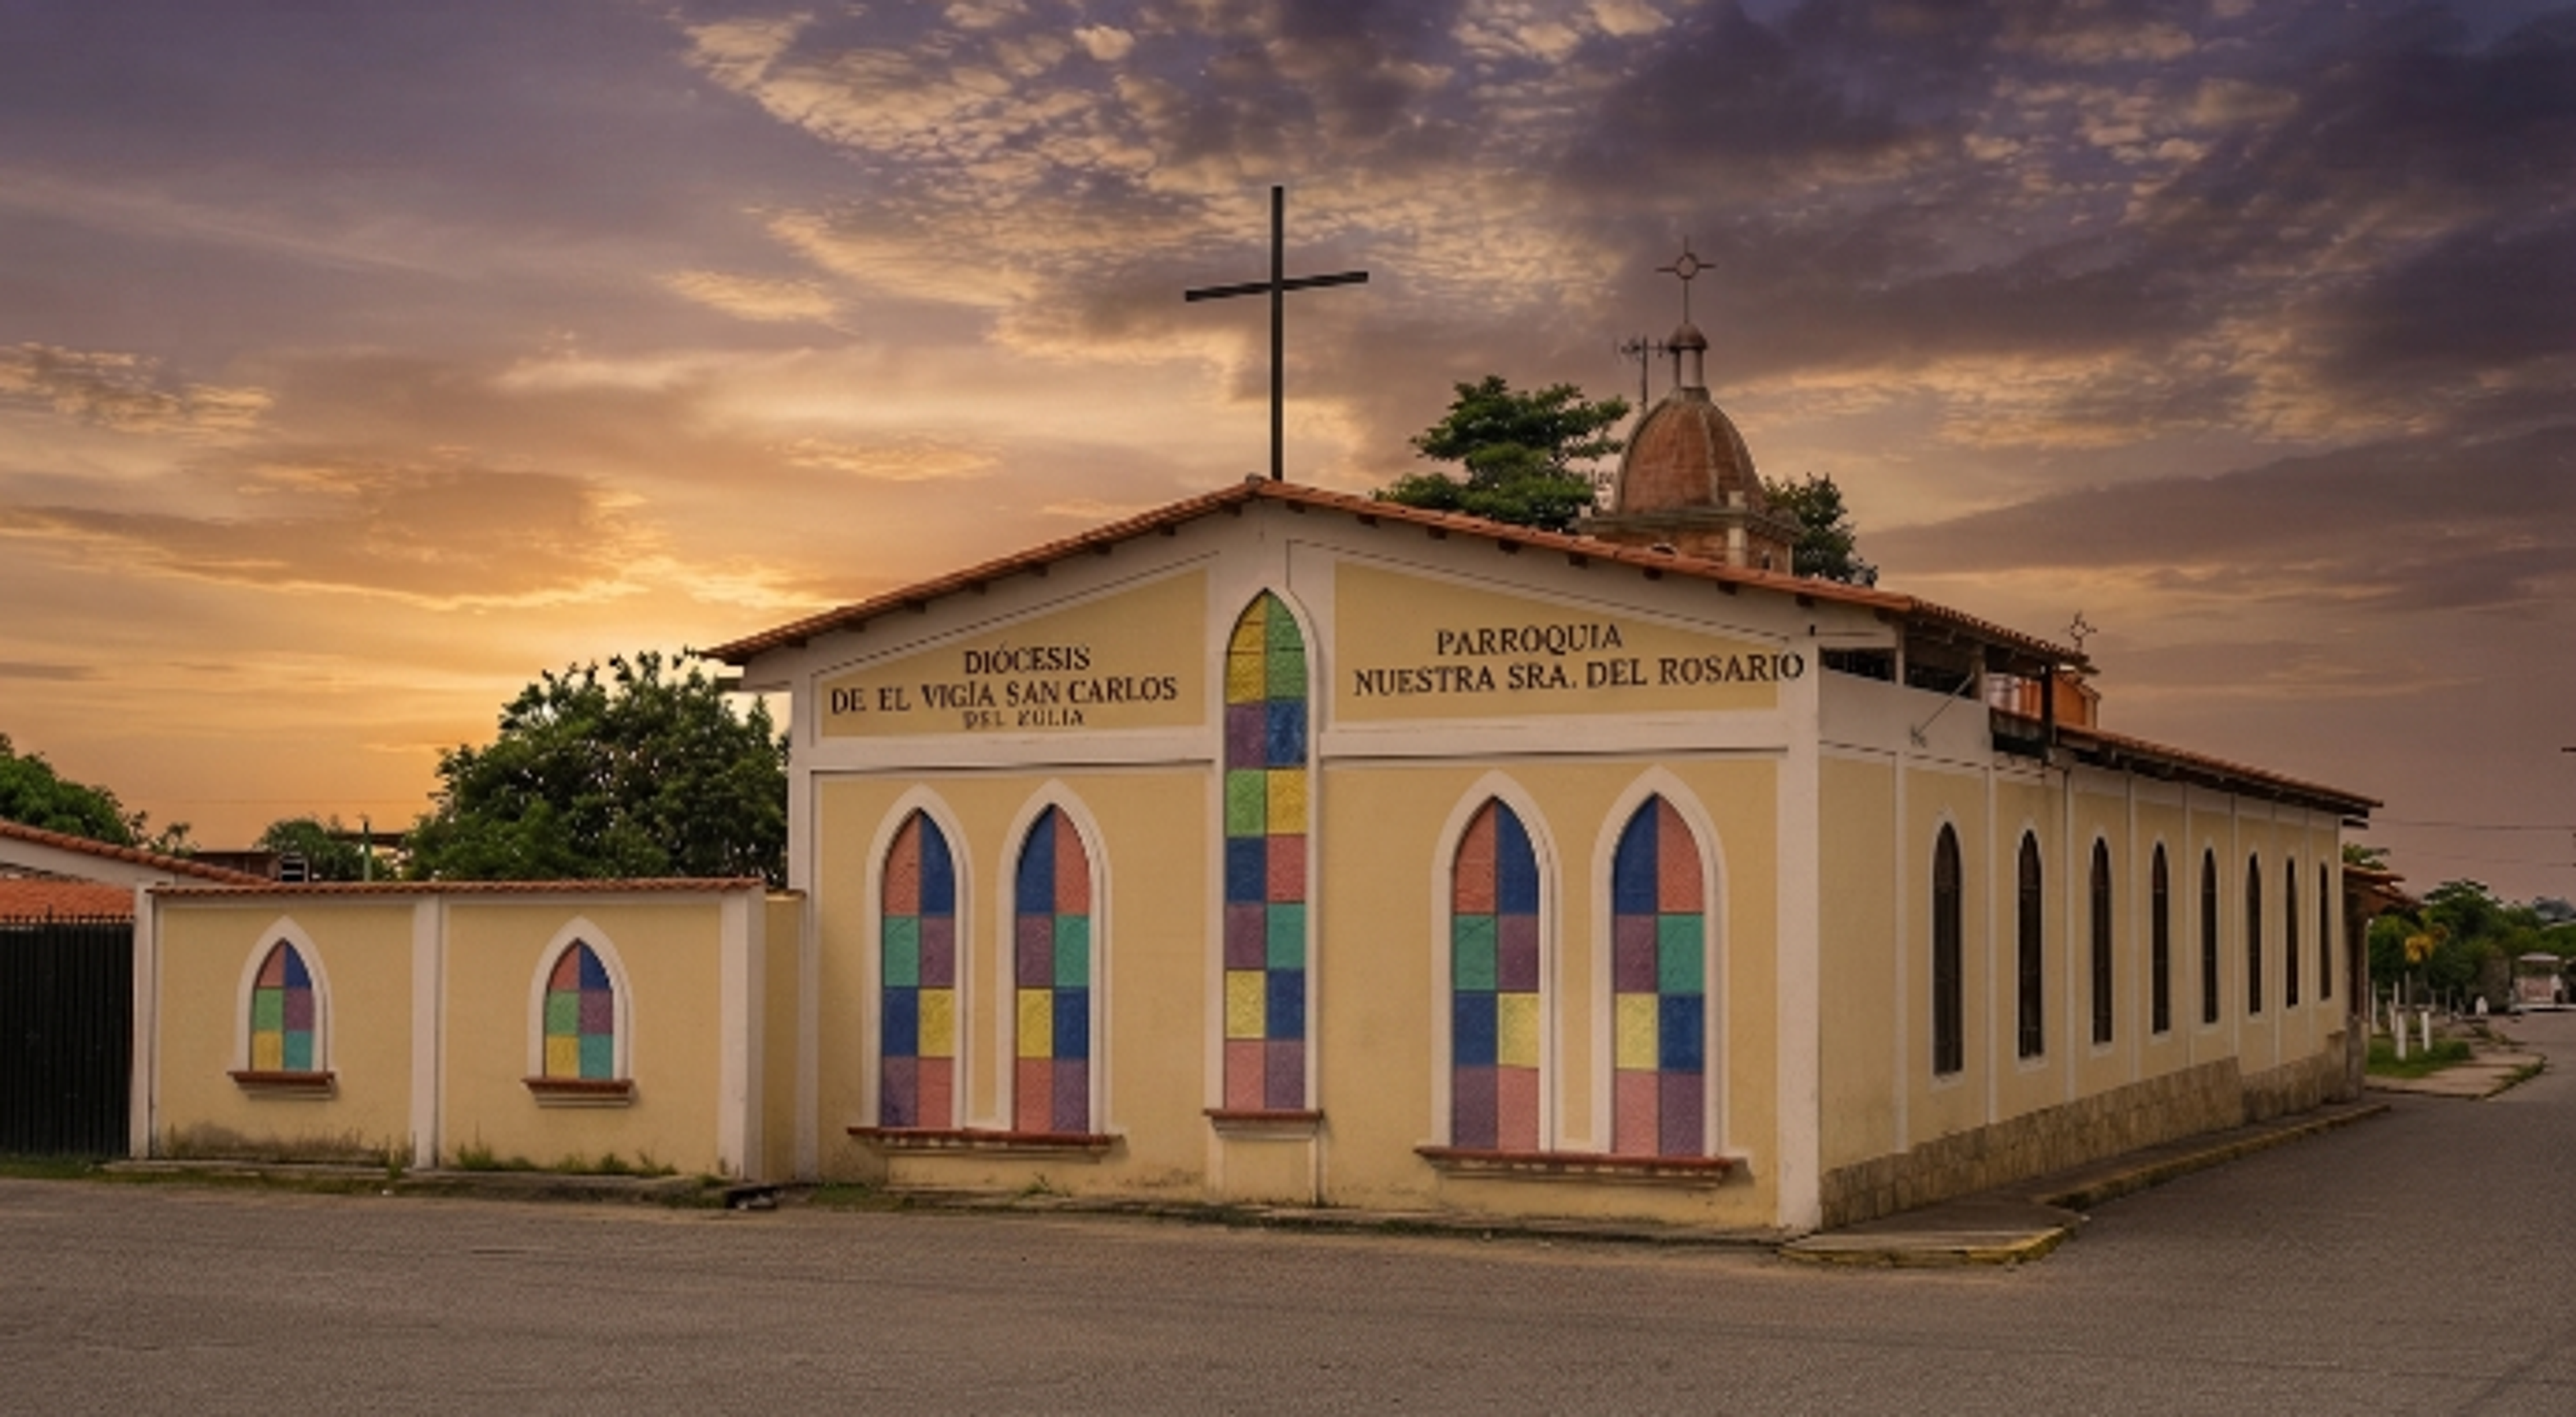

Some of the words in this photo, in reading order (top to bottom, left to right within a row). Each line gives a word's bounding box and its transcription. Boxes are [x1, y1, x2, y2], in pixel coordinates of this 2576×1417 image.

[1436, 624, 1623, 655] PARROQUIA
[964, 642, 1091, 674] DIÓCESIS
[1354, 666, 1496, 696] NUESTRA
[1507, 662, 1577, 690] SRA.
[1587, 658, 1648, 688] DEL
[1658, 651, 1805, 686] ROSARIO
[831, 687, 867, 715] DE
[879, 686, 911, 711] EL
[1006, 680, 1060, 706] SAN
[1067, 676, 1179, 703] CARLOS
[963, 709, 1006, 729] DEL
